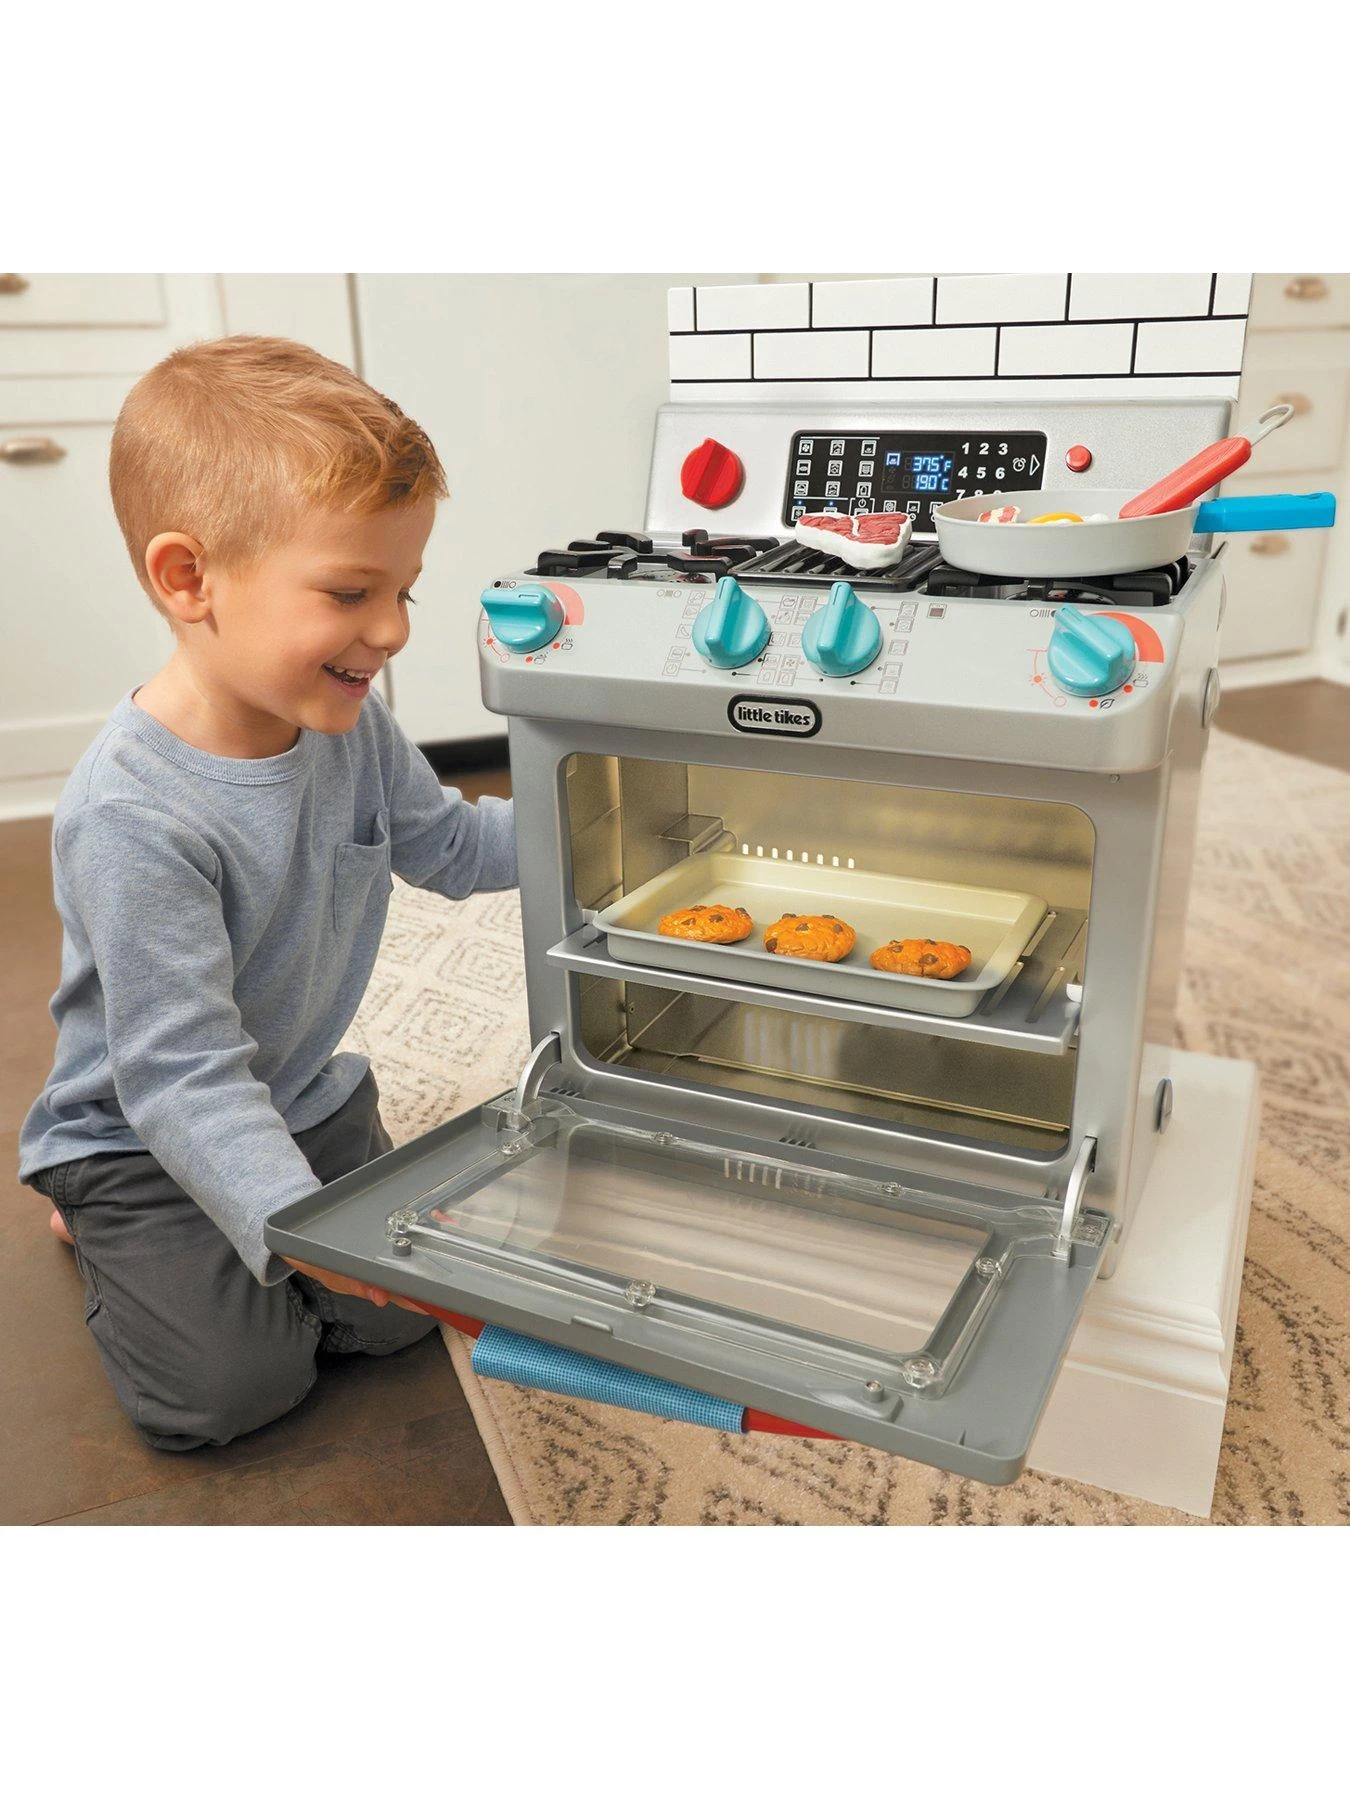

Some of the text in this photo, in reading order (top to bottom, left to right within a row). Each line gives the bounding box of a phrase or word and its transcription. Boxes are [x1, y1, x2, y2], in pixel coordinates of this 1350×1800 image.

[962, 442, 1008, 455] 1 2 3
[957, 466, 1005, 479] 4 5 6
[738, 706, 811, 726] little tikes
